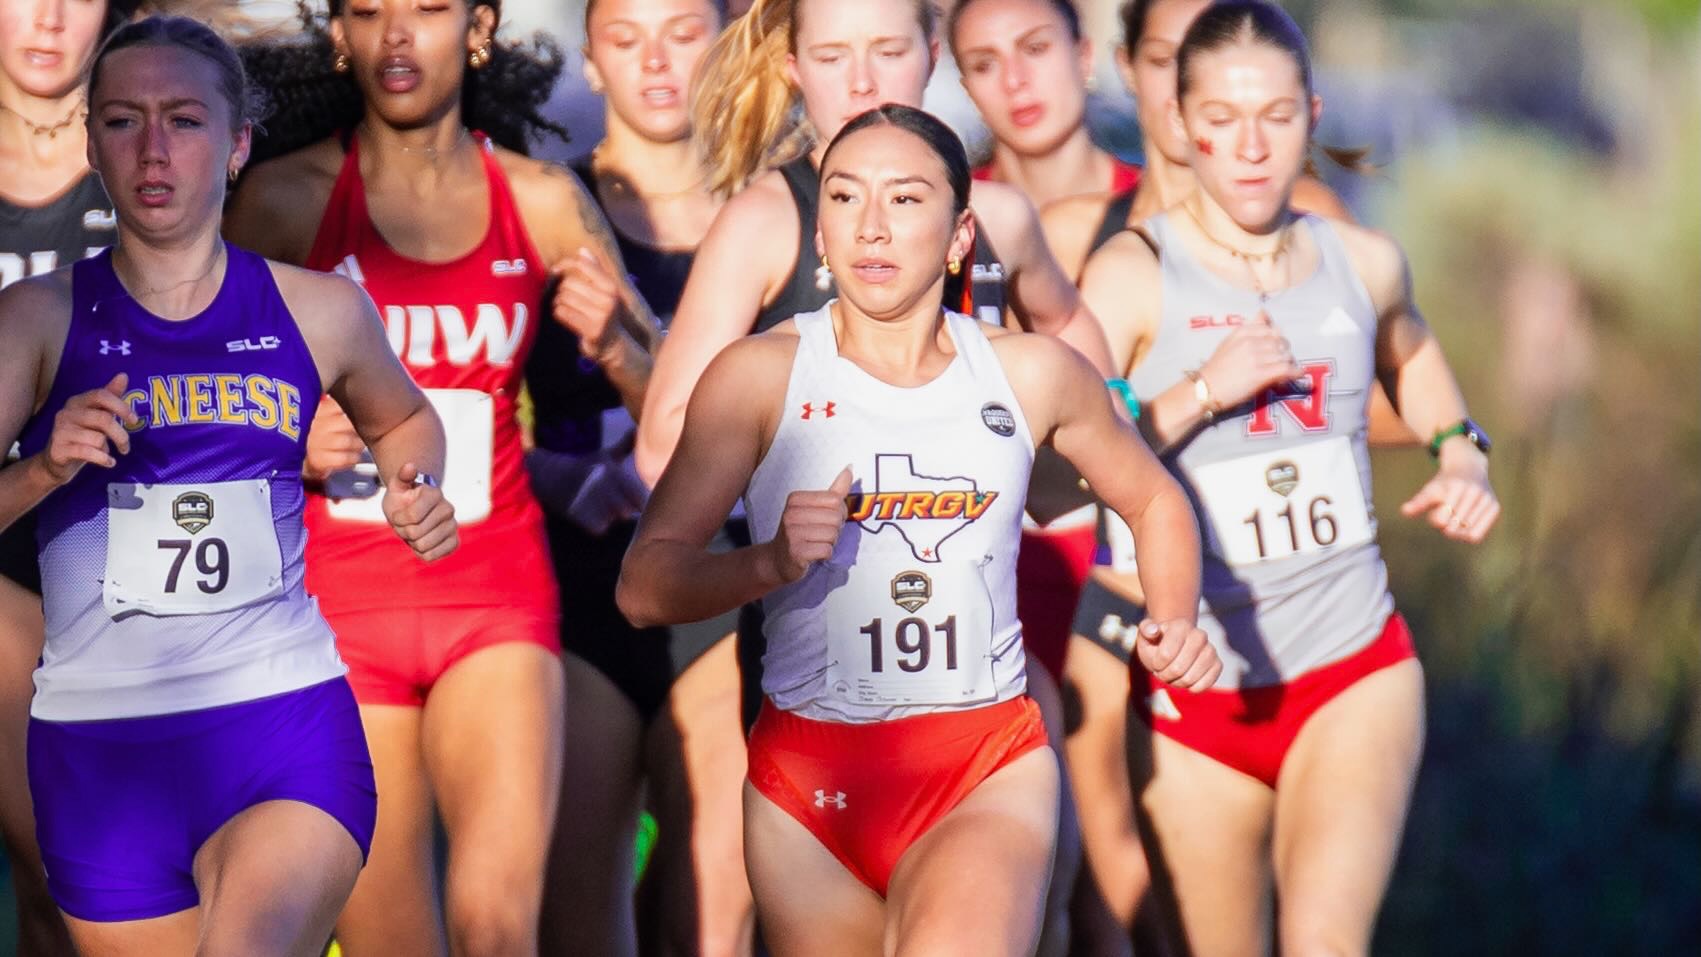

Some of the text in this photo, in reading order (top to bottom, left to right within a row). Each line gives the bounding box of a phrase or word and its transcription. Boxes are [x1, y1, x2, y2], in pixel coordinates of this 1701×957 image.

[226, 335, 281, 353] SLC
[1245, 360, 1334, 437] N
[1243, 495, 1338, 558] 116
[158, 537, 230, 594] 79
[859, 615, 958, 673] 191
